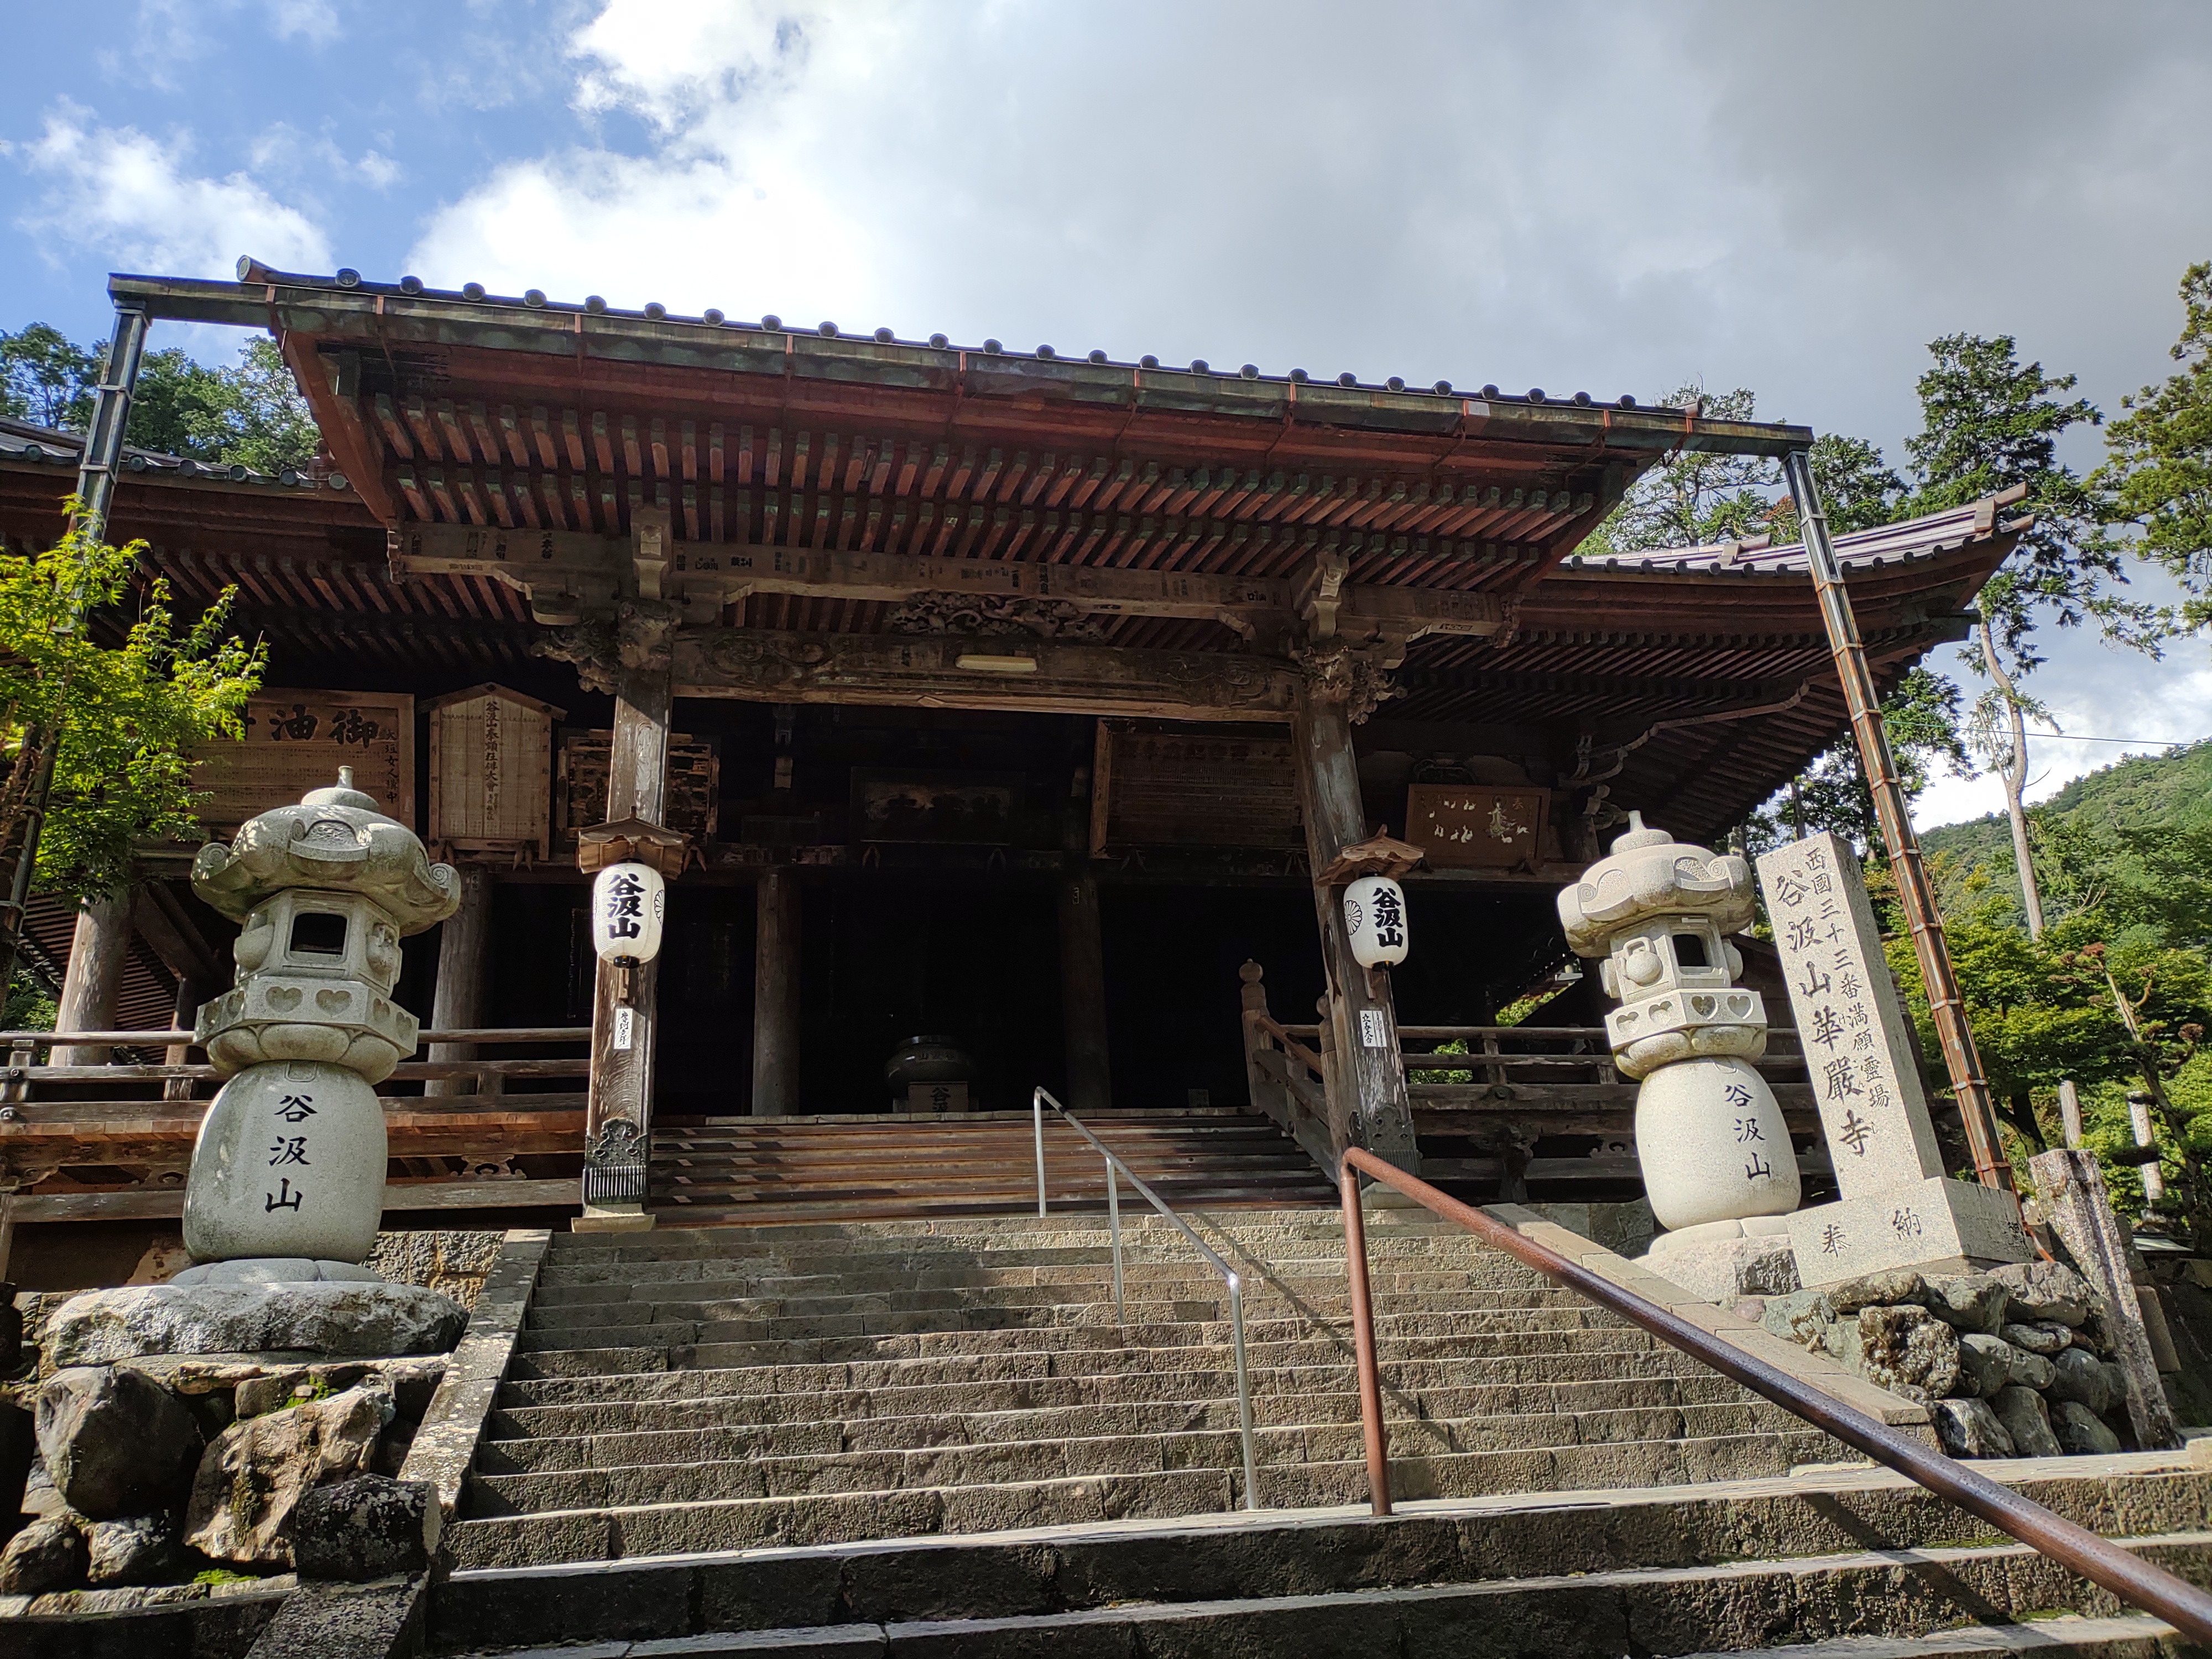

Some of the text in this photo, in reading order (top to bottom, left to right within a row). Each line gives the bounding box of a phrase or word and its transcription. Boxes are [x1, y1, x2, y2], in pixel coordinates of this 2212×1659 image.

[607, 873, 646, 939] 谷汲山
[1372, 888, 1404, 948] 谷汲山
[1362, 1013, 1374, 1044] 立春大吉
[265, 1094, 318, 1213] 谷汲山
[1725, 1084, 1772, 1181] 谷汲山
[1822, 1208, 1922, 1258] 奉納
